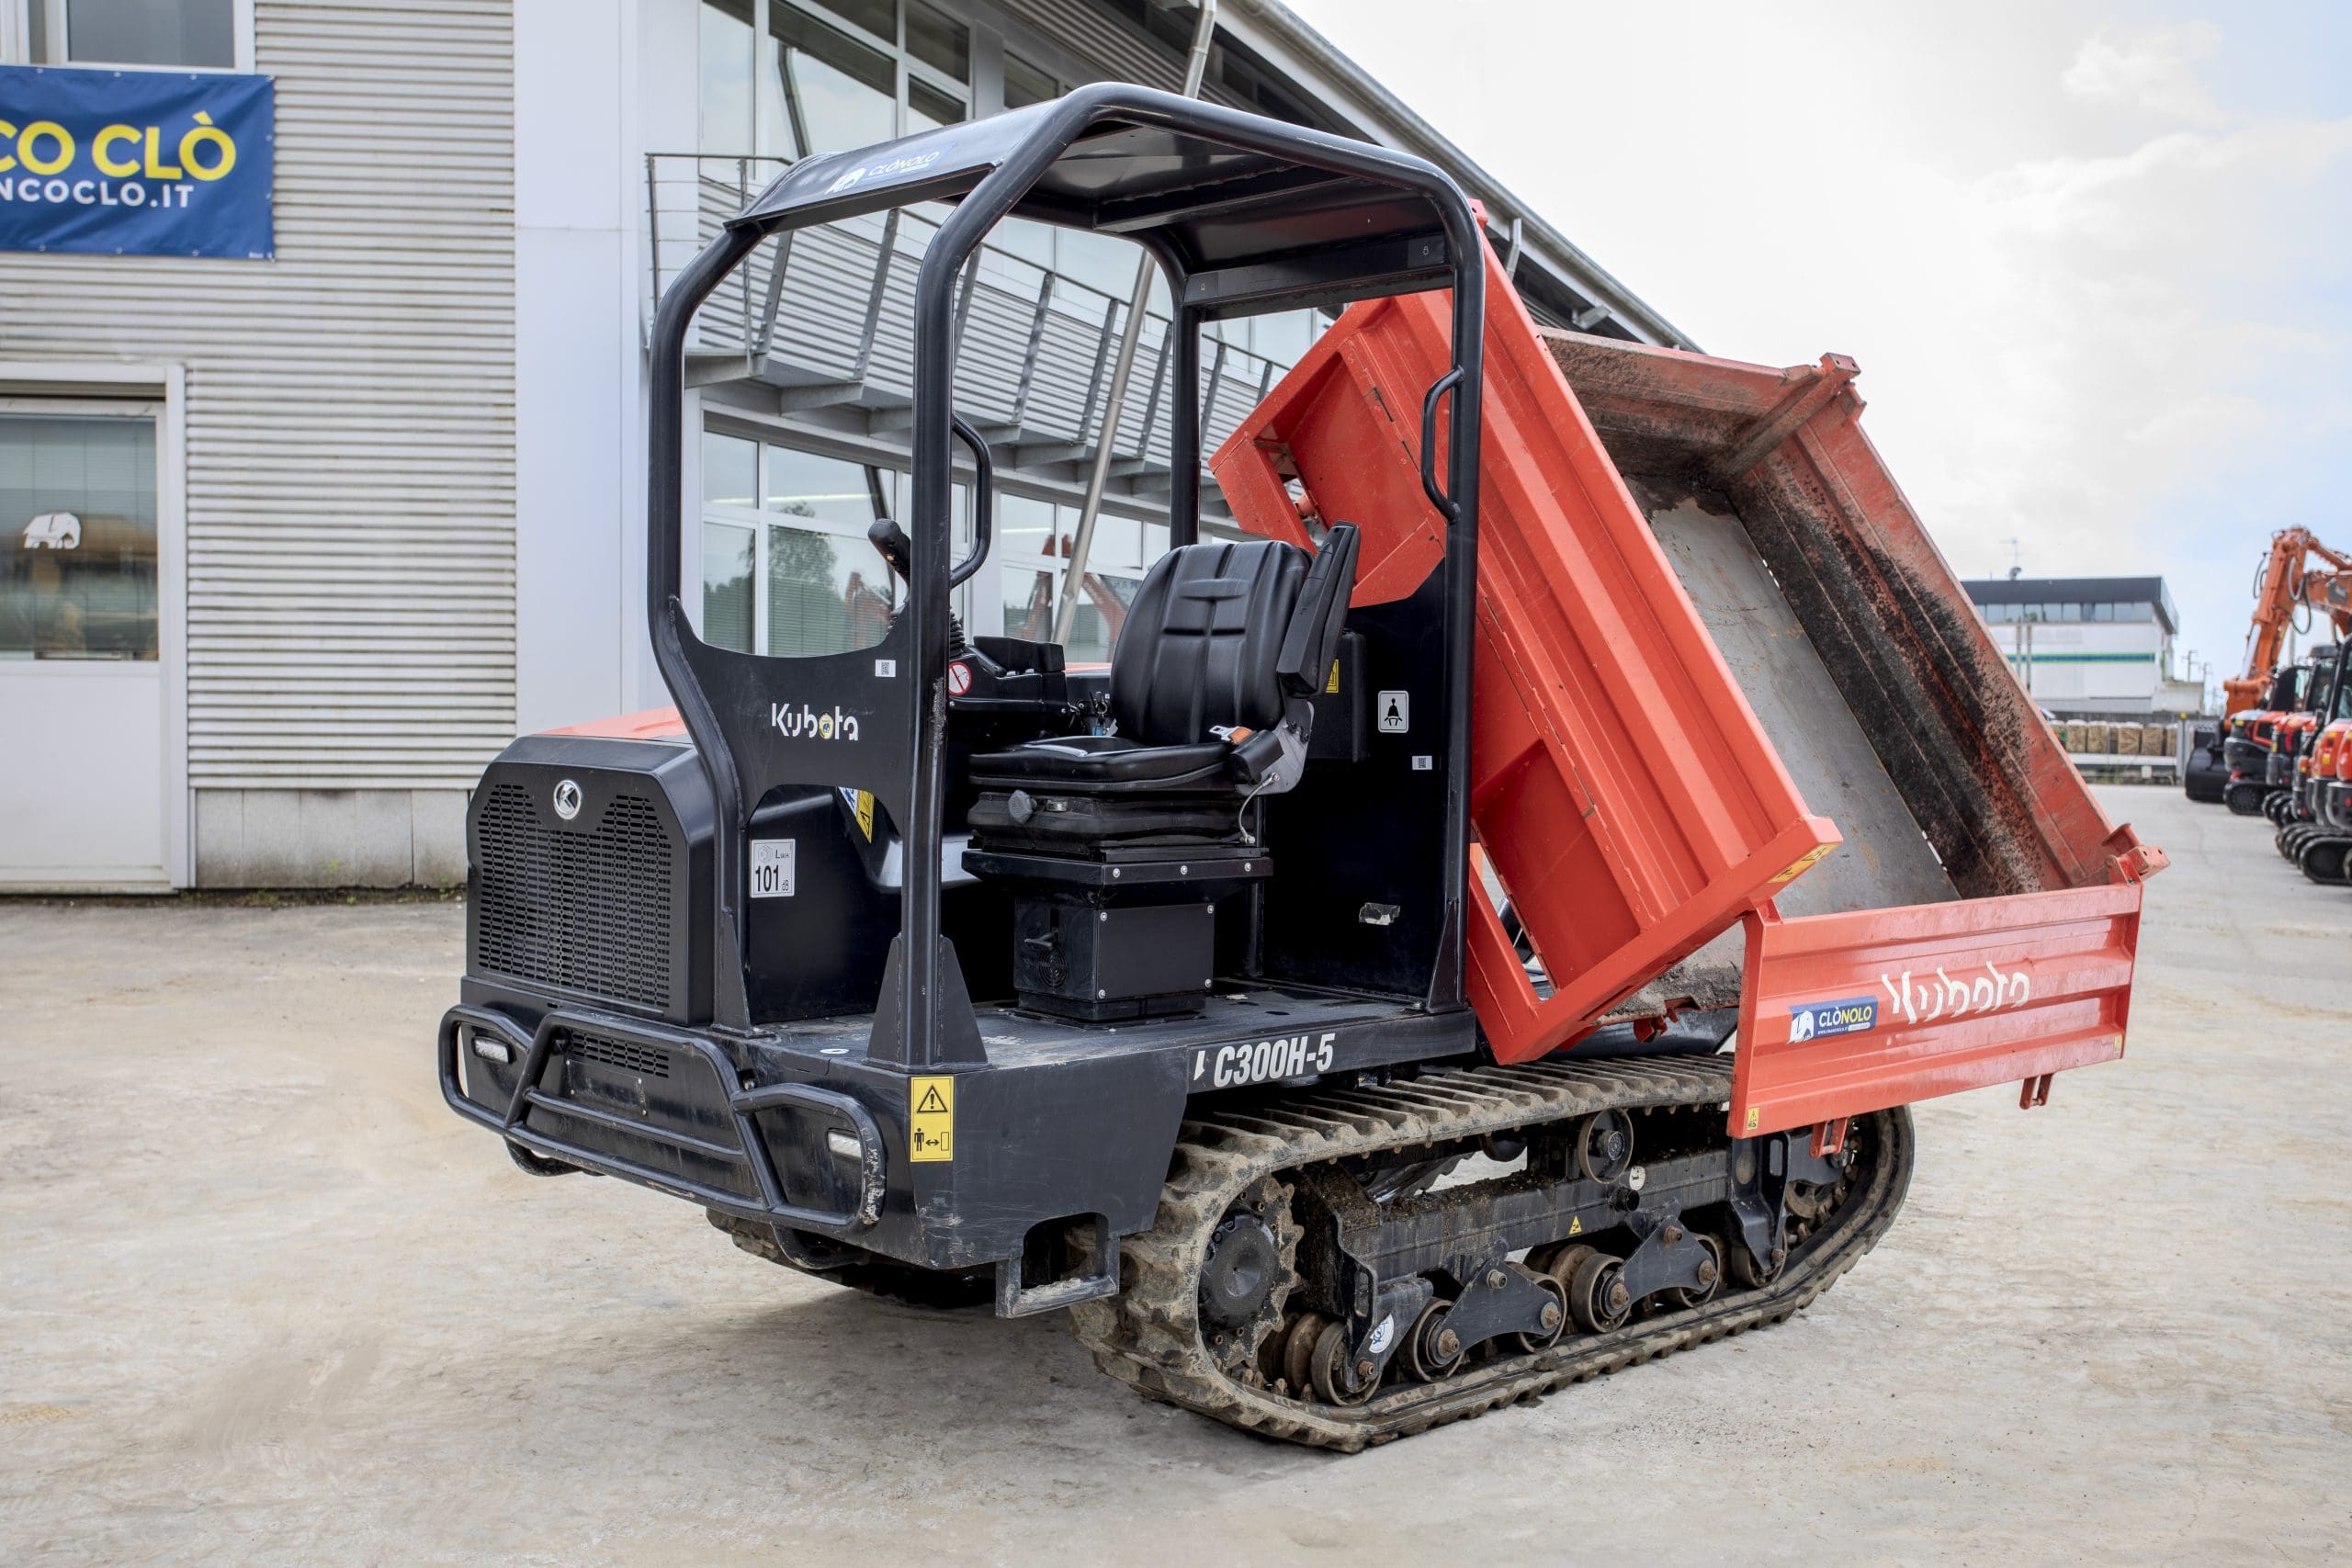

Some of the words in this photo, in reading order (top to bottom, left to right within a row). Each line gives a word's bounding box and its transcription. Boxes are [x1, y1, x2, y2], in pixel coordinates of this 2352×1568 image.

[92, 110, 236, 181] CLÒ
[772, 703, 859, 741] Kubta
[755, 864, 779, 892] 101
[1881, 960, 2030, 1025] Kubota
[1818, 1006, 1872, 1027] CLÒNOLO
